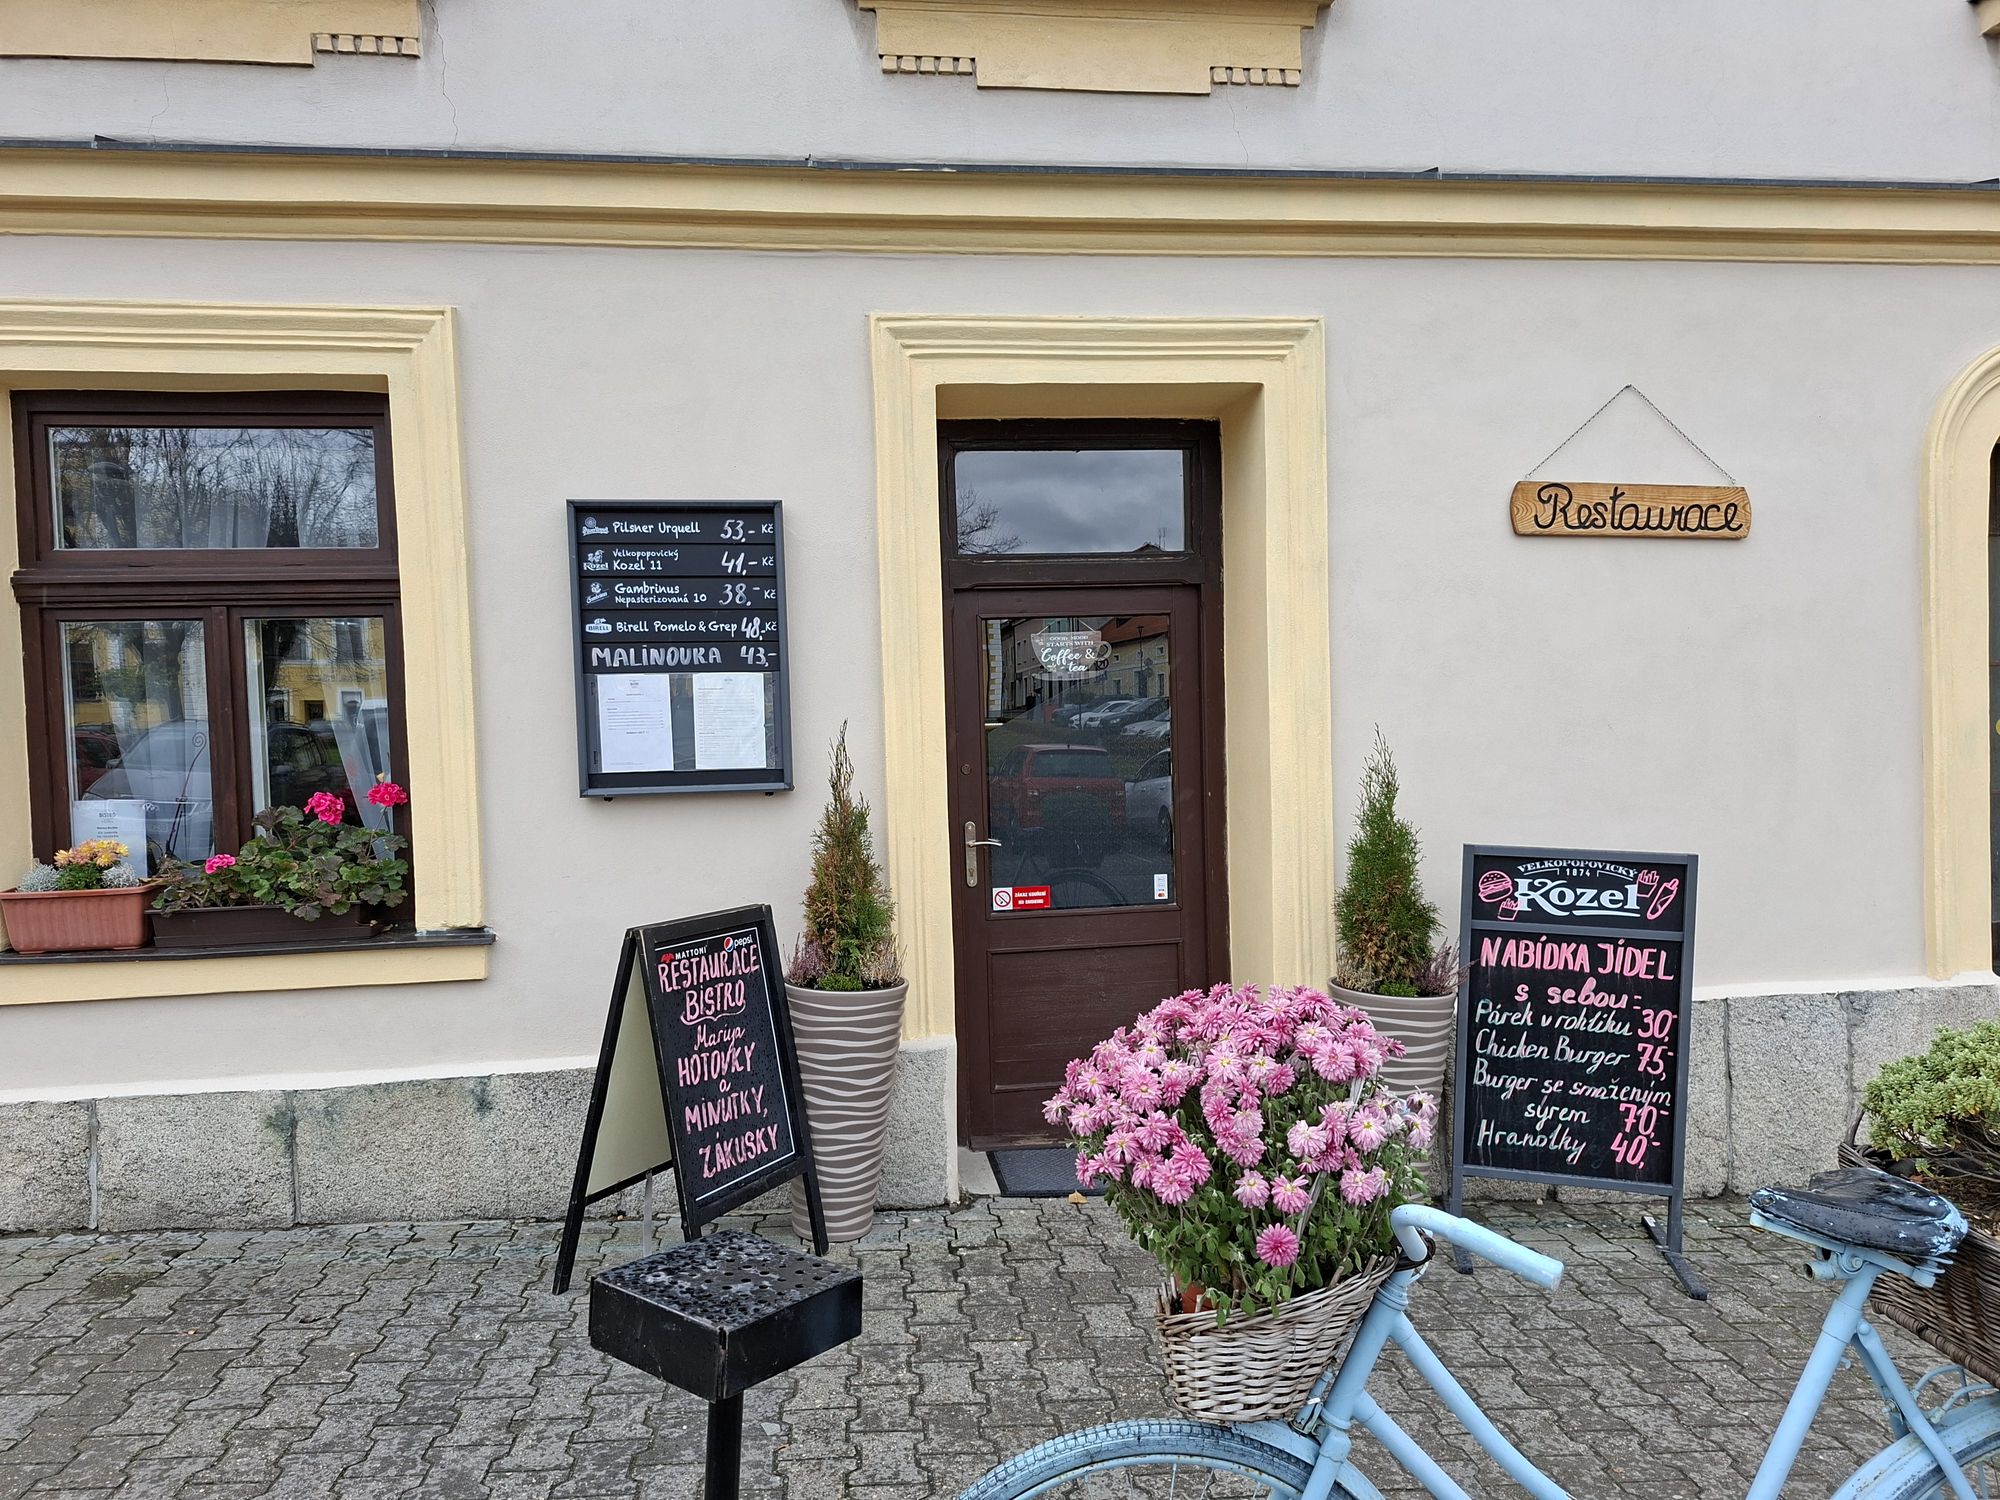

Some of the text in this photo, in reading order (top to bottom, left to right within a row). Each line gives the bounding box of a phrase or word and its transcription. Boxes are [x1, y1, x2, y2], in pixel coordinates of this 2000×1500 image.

[1533, 482, 1743, 532] Restaurace
[612, 521, 654, 534] Pilsner
[658, 521, 700, 539] Urquell
[720, 519, 756, 543] 53,-
[761, 523, 774, 534] Kč
[612, 548, 774, 576] Velkopopovický 41,- Kč
[613, 559, 662, 571] Kozel 11
[614, 581, 680, 595] Gambrinus
[764, 589, 776, 600] Kč
[615, 593, 707, 608] Nepasterizovaná 10
[616, 621, 649, 633] Birell
[653, 621, 697, 633] Pomelo
[698, 620, 706, 632] &
[708, 620, 738, 638] Grep
[765, 621, 777, 631] Kč
[1040, 647, 1082, 666] Coffee
[1084, 648, 1096, 659] &
[1067, 661, 1088, 672] tea
[1517, 858, 1638, 879] VELKOPOPOVICKÝ
[1565, 868, 1591, 878] 1874
[1513, 877, 1641, 917] Kozel
[675, 946, 707, 960] MATTONI
[734, 934, 753, 948] pepsi
[657, 944, 760, 993] RESTAURACE
[1479, 935, 1675, 981] NABÍDKA JÍDEL
[685, 979, 746, 1022] BISTRO
[1514, 983, 1529, 1002] s
[1475, 999, 1534, 1026] Párek
[1540, 1013, 1553, 1029] v
[677, 1041, 756, 1088] HOTOVKY
[1475, 1028, 1550, 1059] Chicken
[1553, 1034, 1631, 1075] Burger
[719, 1078, 732, 1093] a
[1472, 1057, 1539, 1100] Burger
[1540, 1078, 1563, 1095] se
[1523, 1095, 1591, 1132] sýrem
[698, 1123, 778, 1179] ZÁKUSKY
[1610, 1132, 1662, 1170] 40,-
